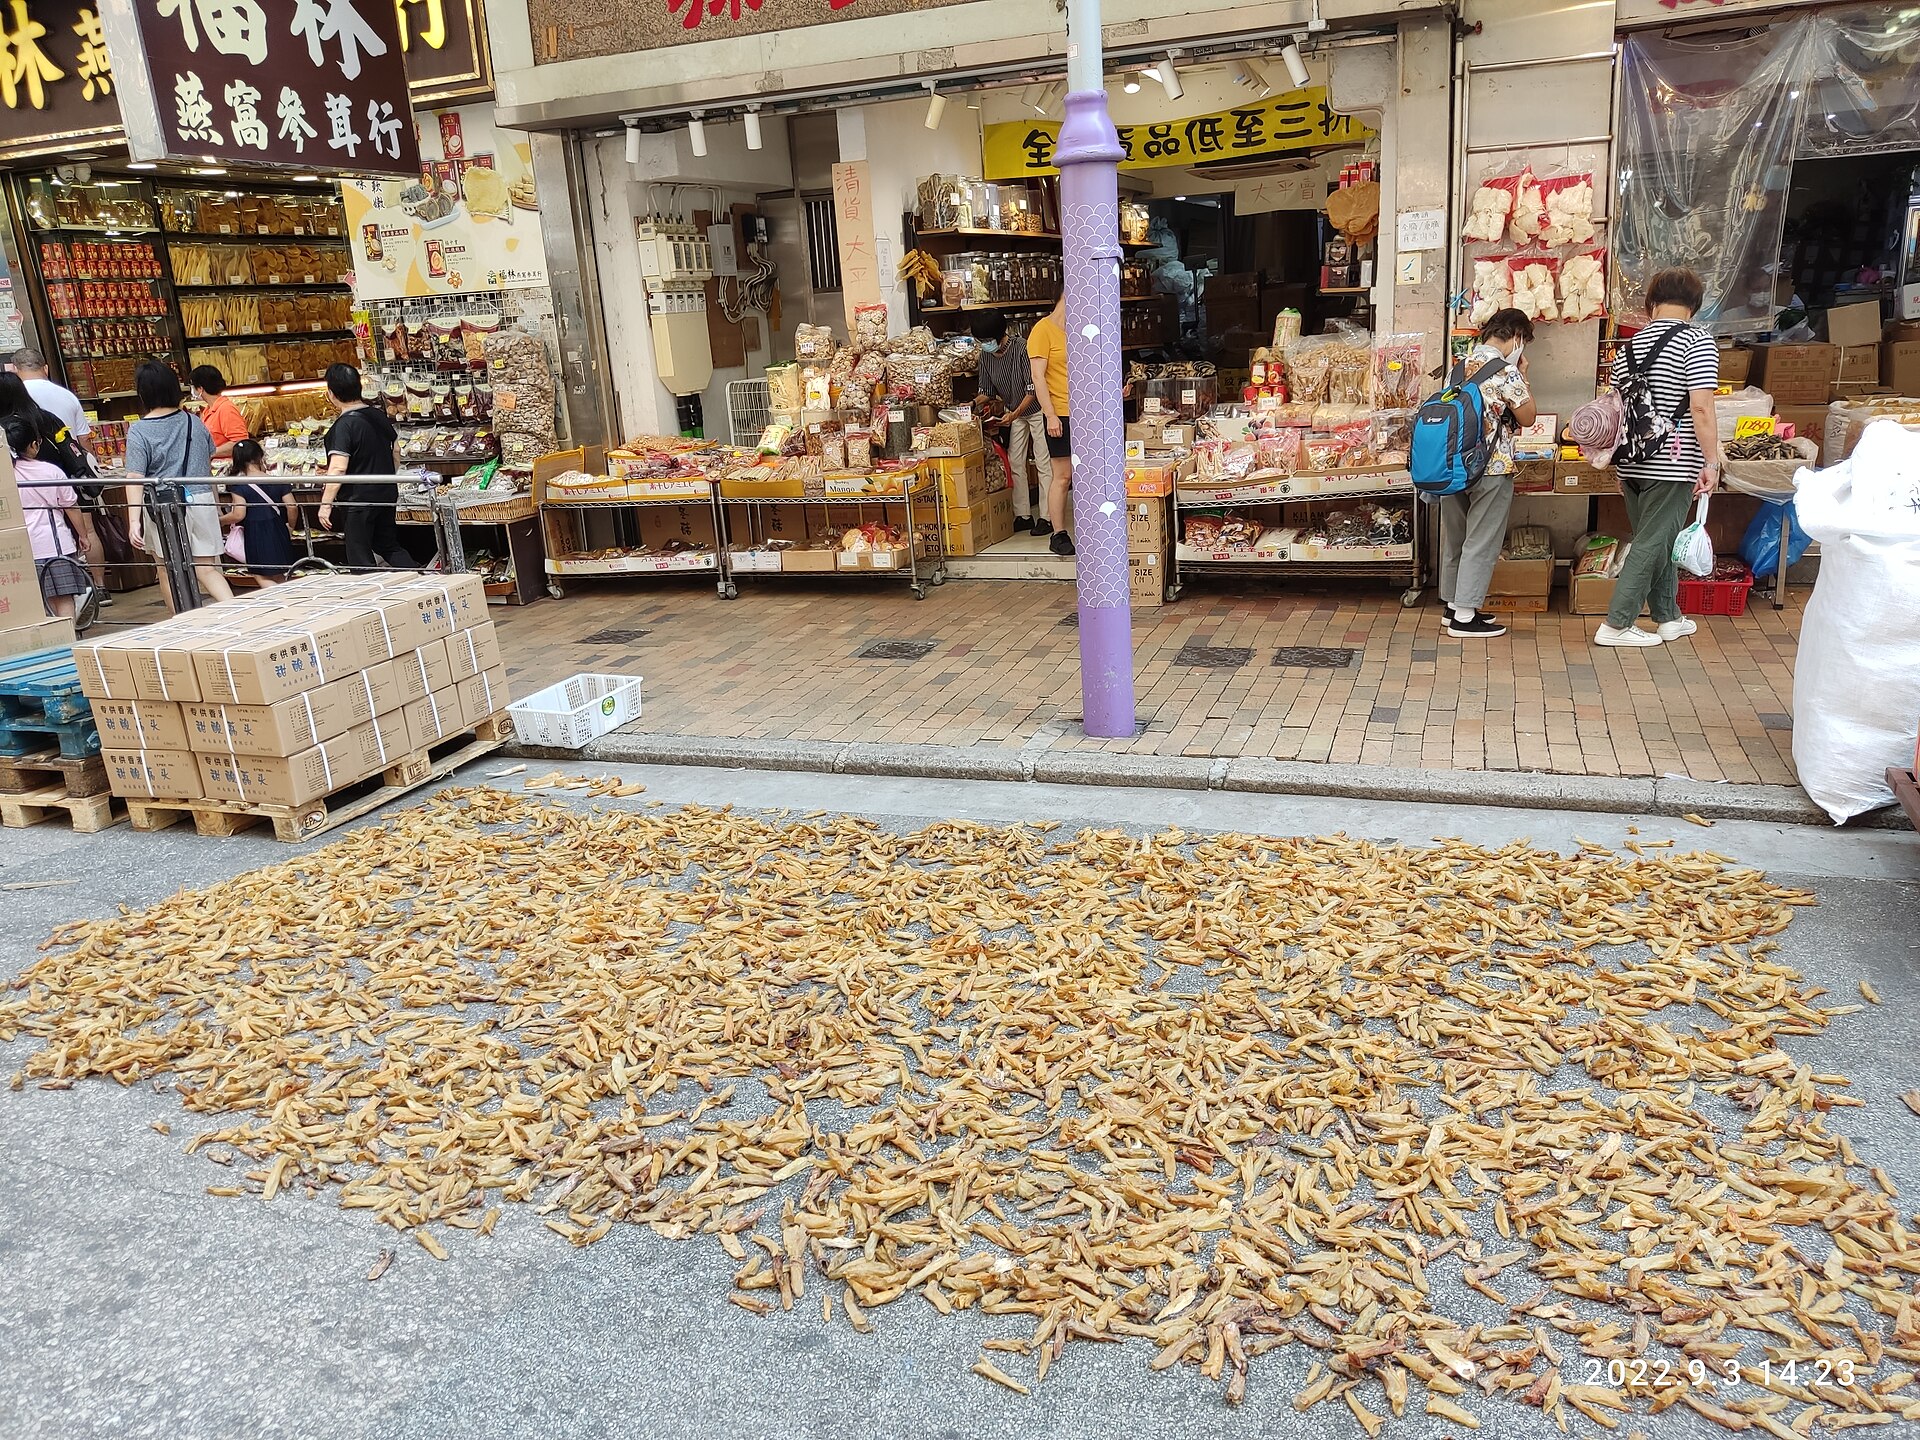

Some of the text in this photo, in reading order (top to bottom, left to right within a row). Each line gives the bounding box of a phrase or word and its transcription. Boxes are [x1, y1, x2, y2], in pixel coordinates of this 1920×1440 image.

[174, 70, 404, 160] 燕窩參茸行
[1131, 514, 1149, 522] SIZE
[1134, 568, 1153, 576] SIZE
